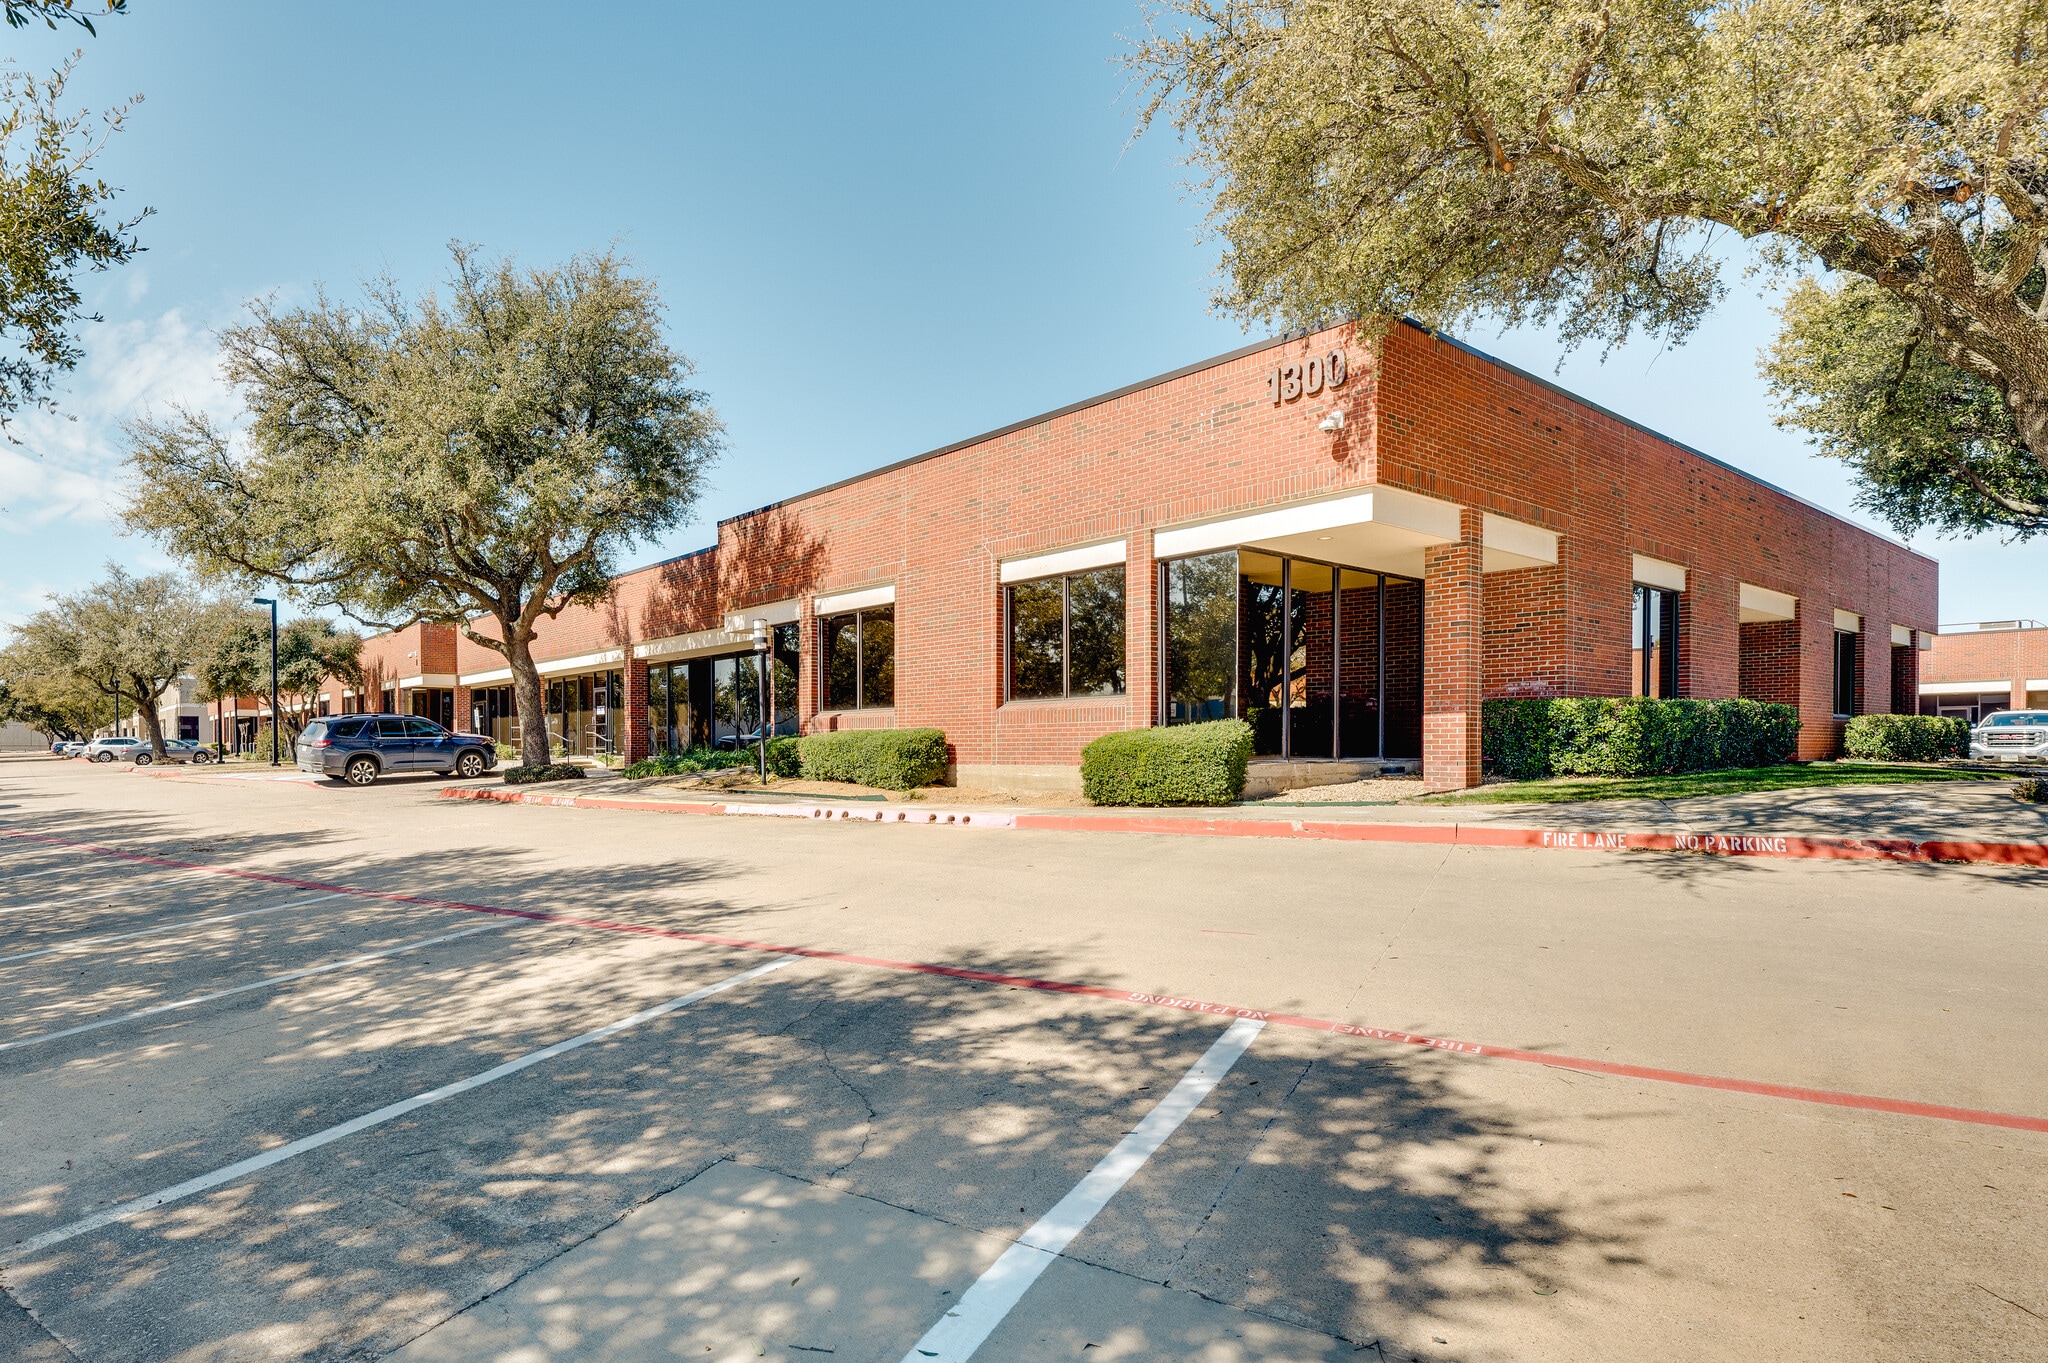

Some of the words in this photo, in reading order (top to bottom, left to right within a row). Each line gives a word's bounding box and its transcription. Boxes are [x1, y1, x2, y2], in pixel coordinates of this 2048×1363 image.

[1267, 348, 1347, 406] 1300
[1543, 831, 1578, 847] FIRE
[1583, 833, 1627, 849] LANE
[1675, 835, 1699, 850] NO
[1705, 836, 1787, 853] PARKING
[1128, 992, 1230, 1014] PARKING
[1235, 1009, 1270, 1020] NO
[1338, 1024, 1412, 1043] LANE
[1422, 1037, 1482, 1054] FIRE
